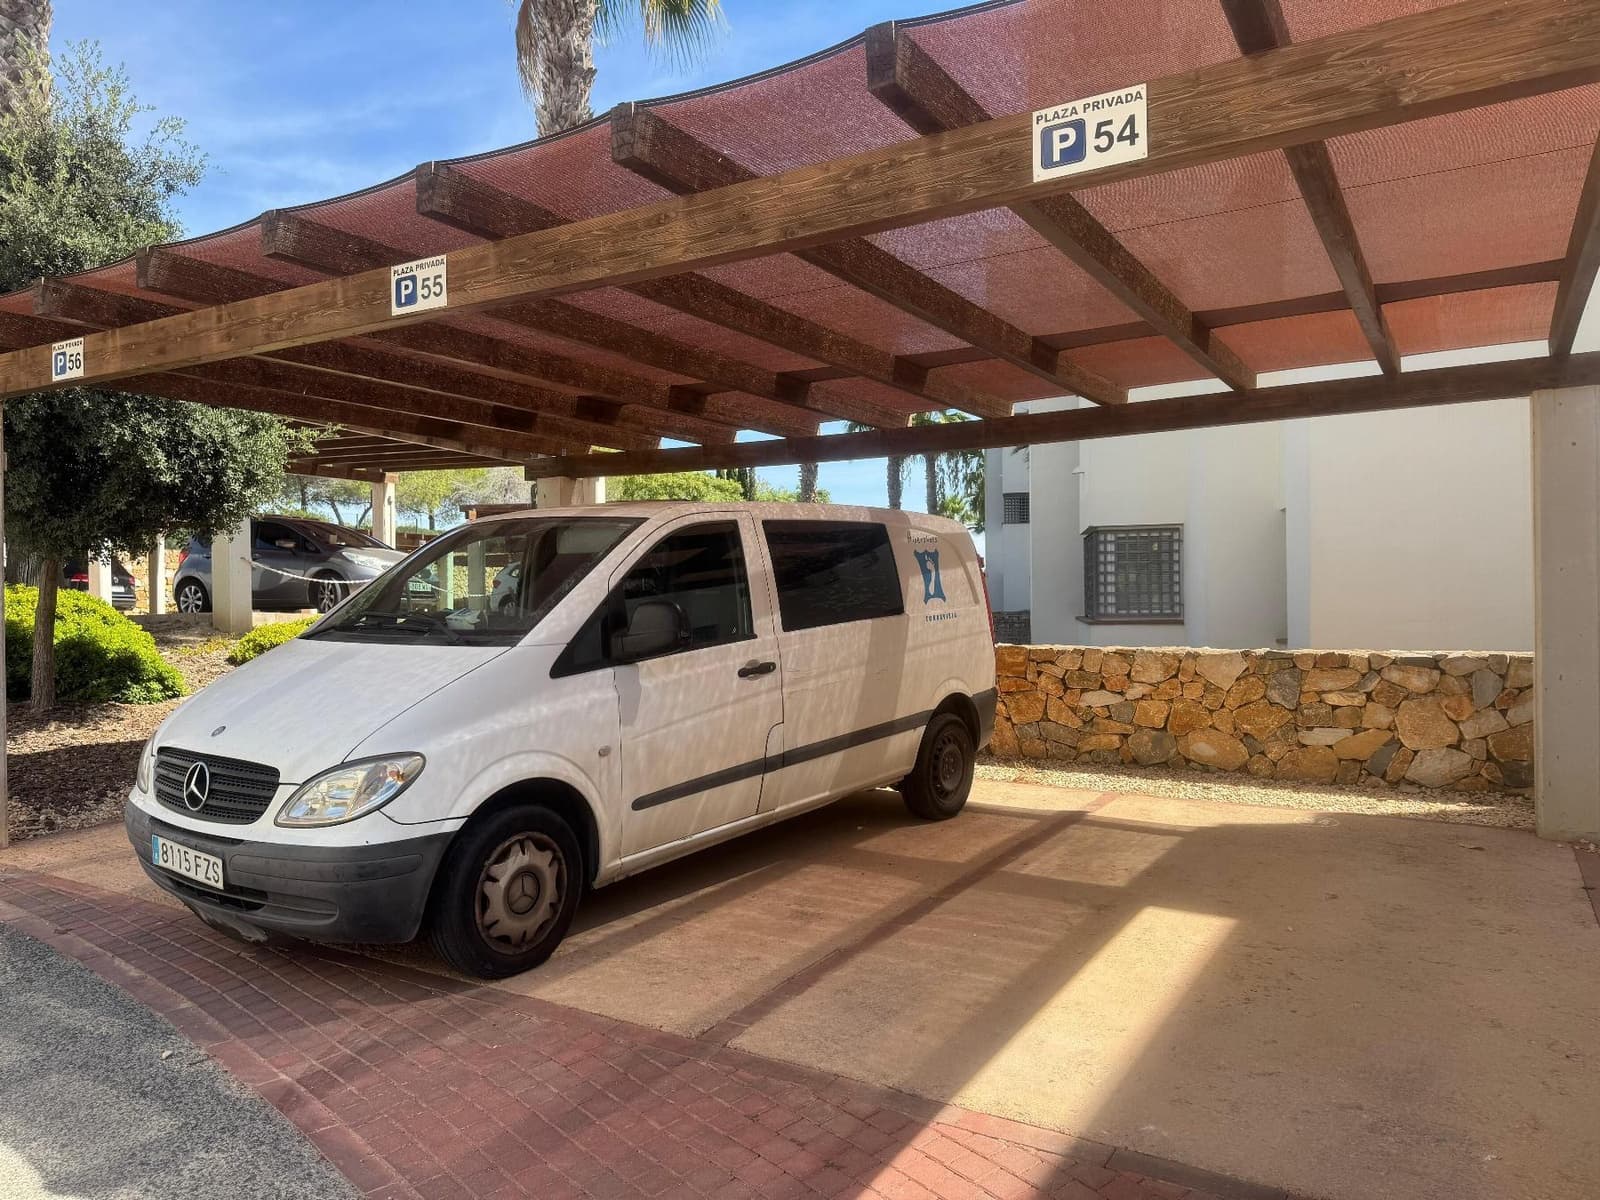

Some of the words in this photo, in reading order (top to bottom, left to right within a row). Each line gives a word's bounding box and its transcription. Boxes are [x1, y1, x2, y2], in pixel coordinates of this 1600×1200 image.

[1036, 106, 1078, 125] PLAZA
[1083, 90, 1143, 113] PRIVADA
[1052, 127, 1077, 163] P
[1093, 113, 1139, 153] 54
[393, 265, 414, 277] PLAZA
[415, 258, 445, 271] PRIVADA
[400, 279, 414, 304] P
[420, 274, 443, 300] 55
[68, 352, 82, 371] 56
[161, 842, 192, 873] 8115
[194, 854, 220, 884] FZS
